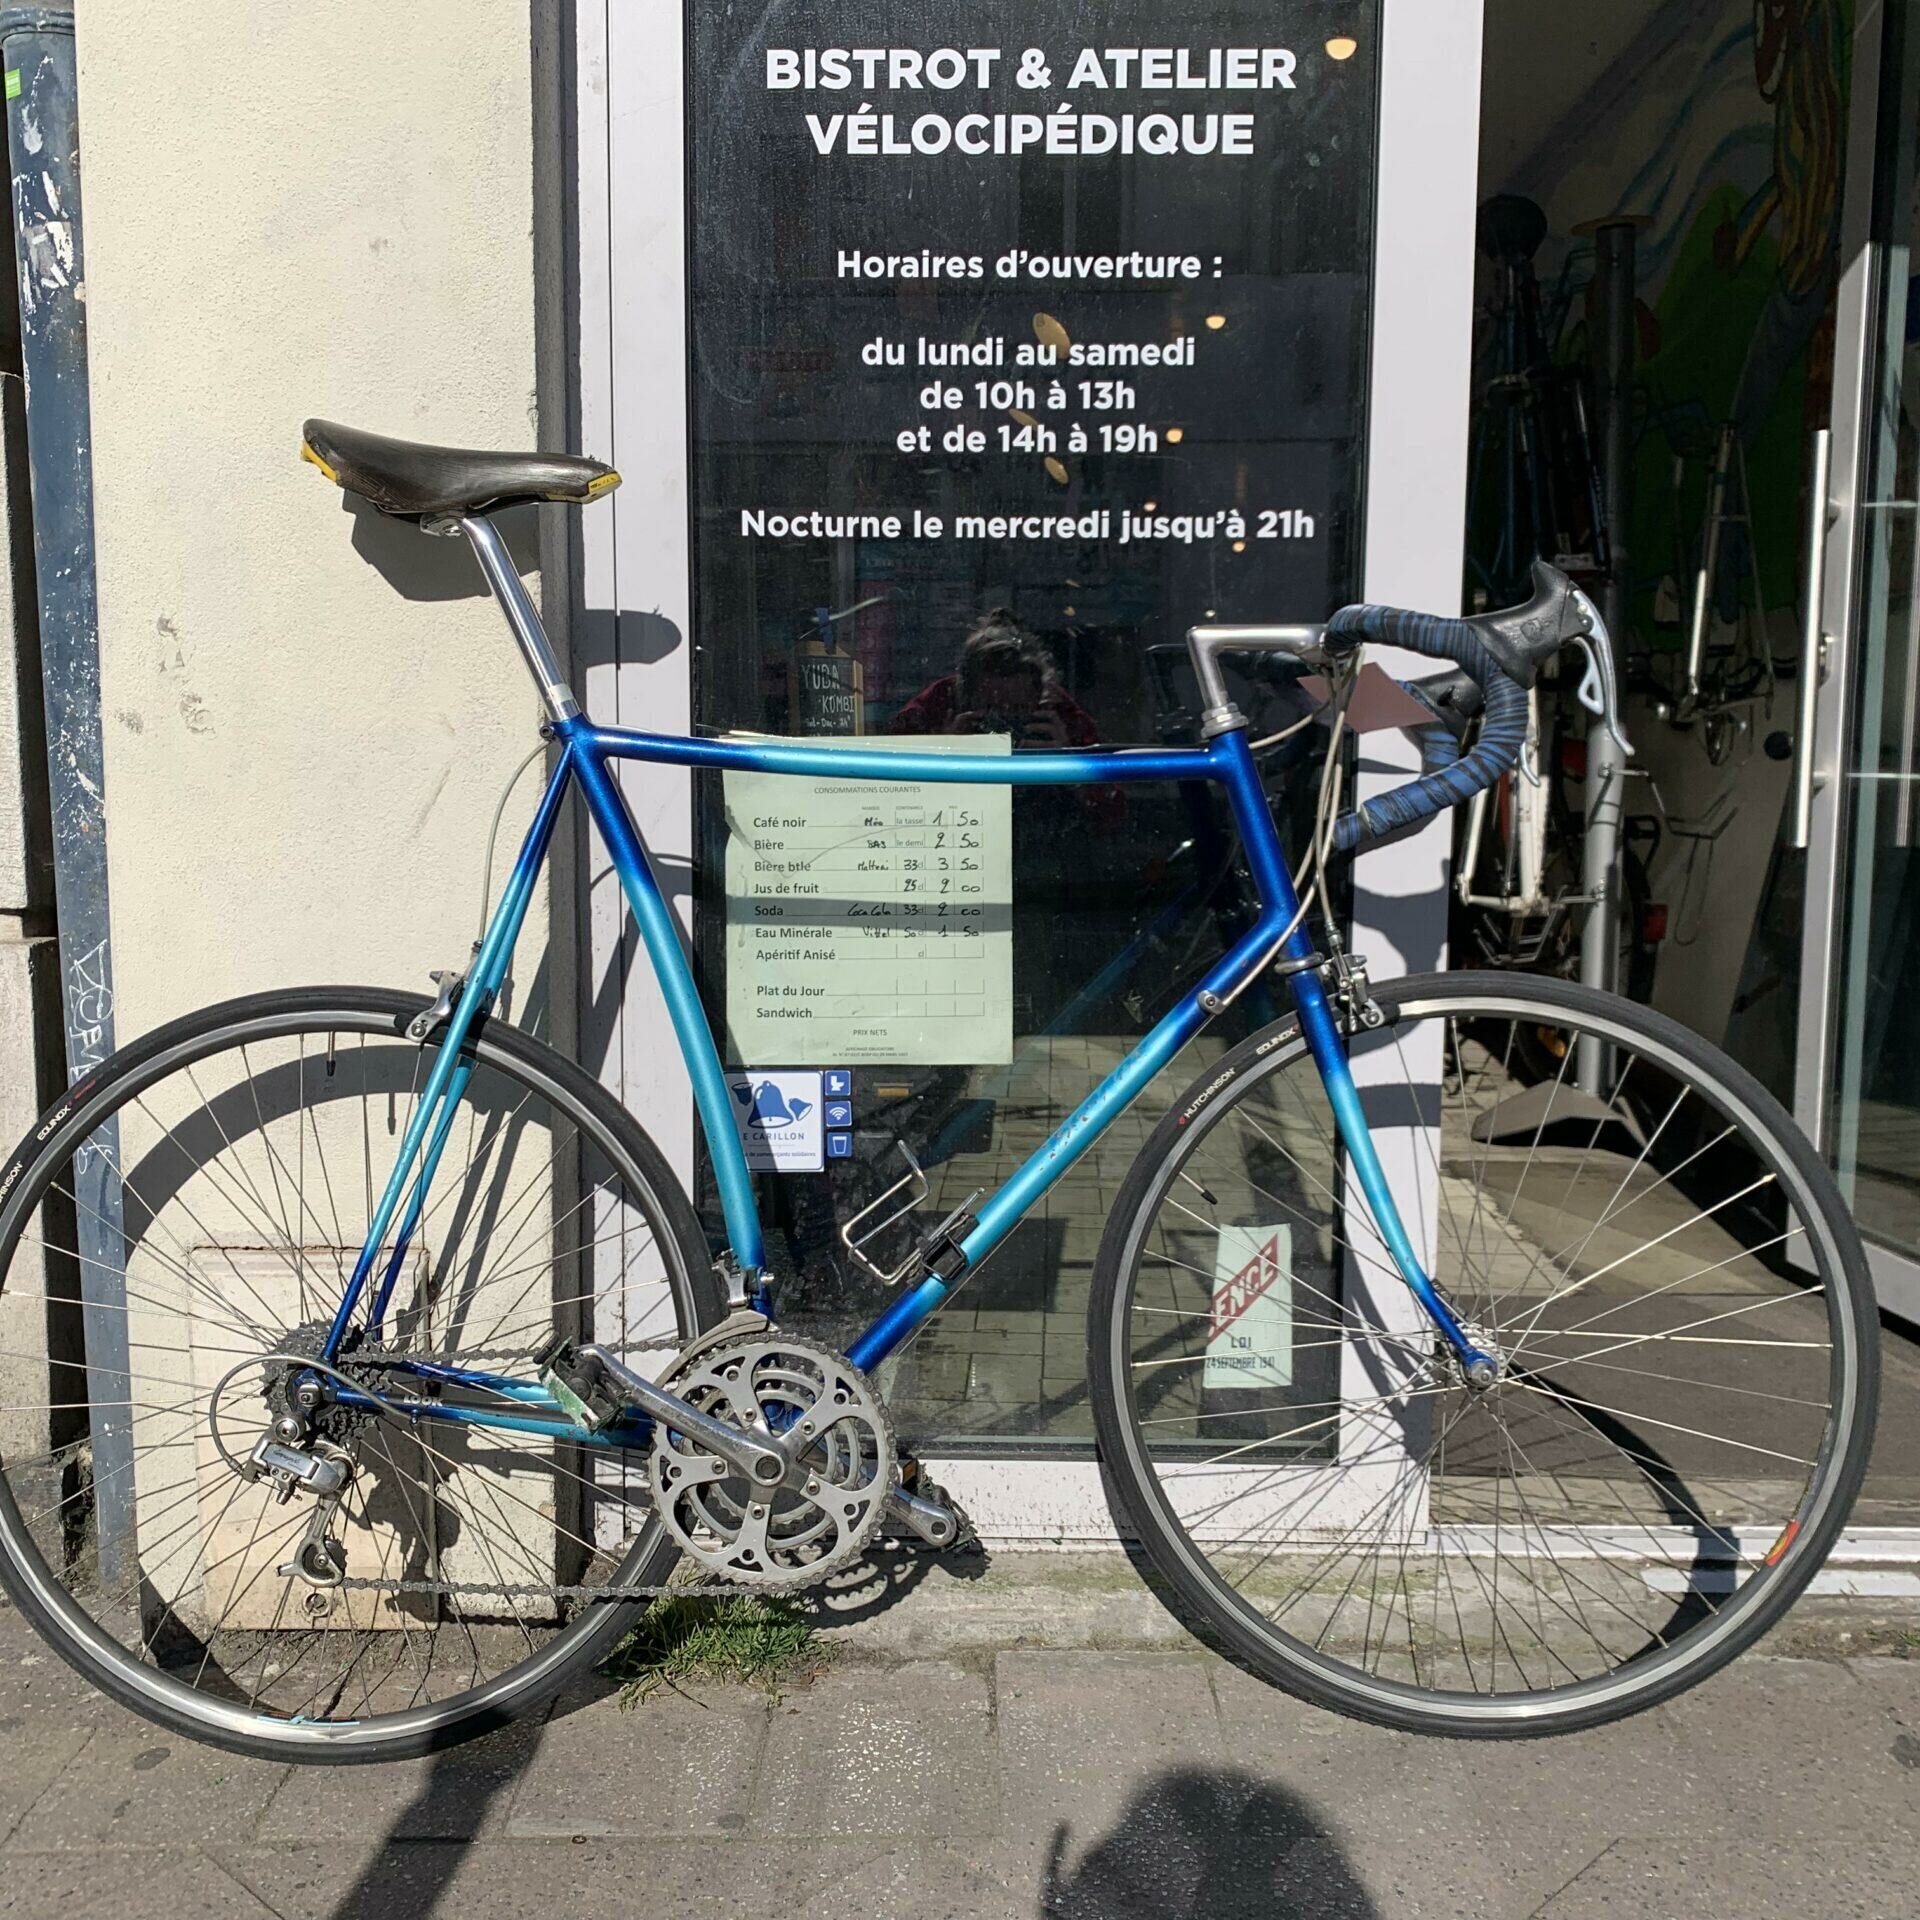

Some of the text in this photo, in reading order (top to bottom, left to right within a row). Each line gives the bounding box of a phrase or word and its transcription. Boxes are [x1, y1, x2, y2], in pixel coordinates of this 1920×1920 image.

[766, 47, 1297, 90] BISTROT & ATELIER
[804, 104, 1255, 155] VÉLOCIPÉDIQUE
[837, 249, 984, 279] Horaires
[995, 249, 1202, 279] d’ouverture
[861, 336, 905, 366] du
[918, 337, 1004, 366] lundi
[1015, 343, 1057, 366] au
[1068, 336, 1195, 366] samedi
[920, 379, 1135, 410] de 10h à 13h
[896, 423, 1158, 453] et de 14h à 19h
[741, 509, 1314, 546] Nocturne le mercredi jusqu’à 21h
[814, 786, 921, 794] CONSOMMATIONS COURANTES
[753, 816, 780, 828] Café
[782, 816, 807, 828] noir
[933, 810, 943, 826] 1
[754, 838, 784, 850] Bière
[905, 839, 924, 847] demi
[934, 832, 945, 849] 2
[938, 857, 949, 871] 3
[754, 884, 773, 894] Jus
[775, 883, 790, 894] de
[793, 882, 820, 894] fruit
[940, 878, 950, 894] 2
[754, 905, 784, 916] Soda
[938, 902, 949, 917] 2
[755, 927, 777, 938] Eau
[779, 927, 833, 938] Minérale
[938, 924, 948, 937] 1
[756, 949, 801, 962] Apéritif
[803, 949, 836, 961] Anisé
[756, 985, 825, 997] Plat du Jour
[756, 1007, 813, 1019] Sandwich
[1256, 1027, 1296, 1055] EQUINOX
[1183, 1066, 1236, 1118] HUTCHINSON
[36, 1104, 72, 1141] EQUINOX
[752, 1132, 805, 1141] CARILLON
[1231, 1336, 1252, 1349] LOI
[403, 1394, 443, 1407] LOOK
